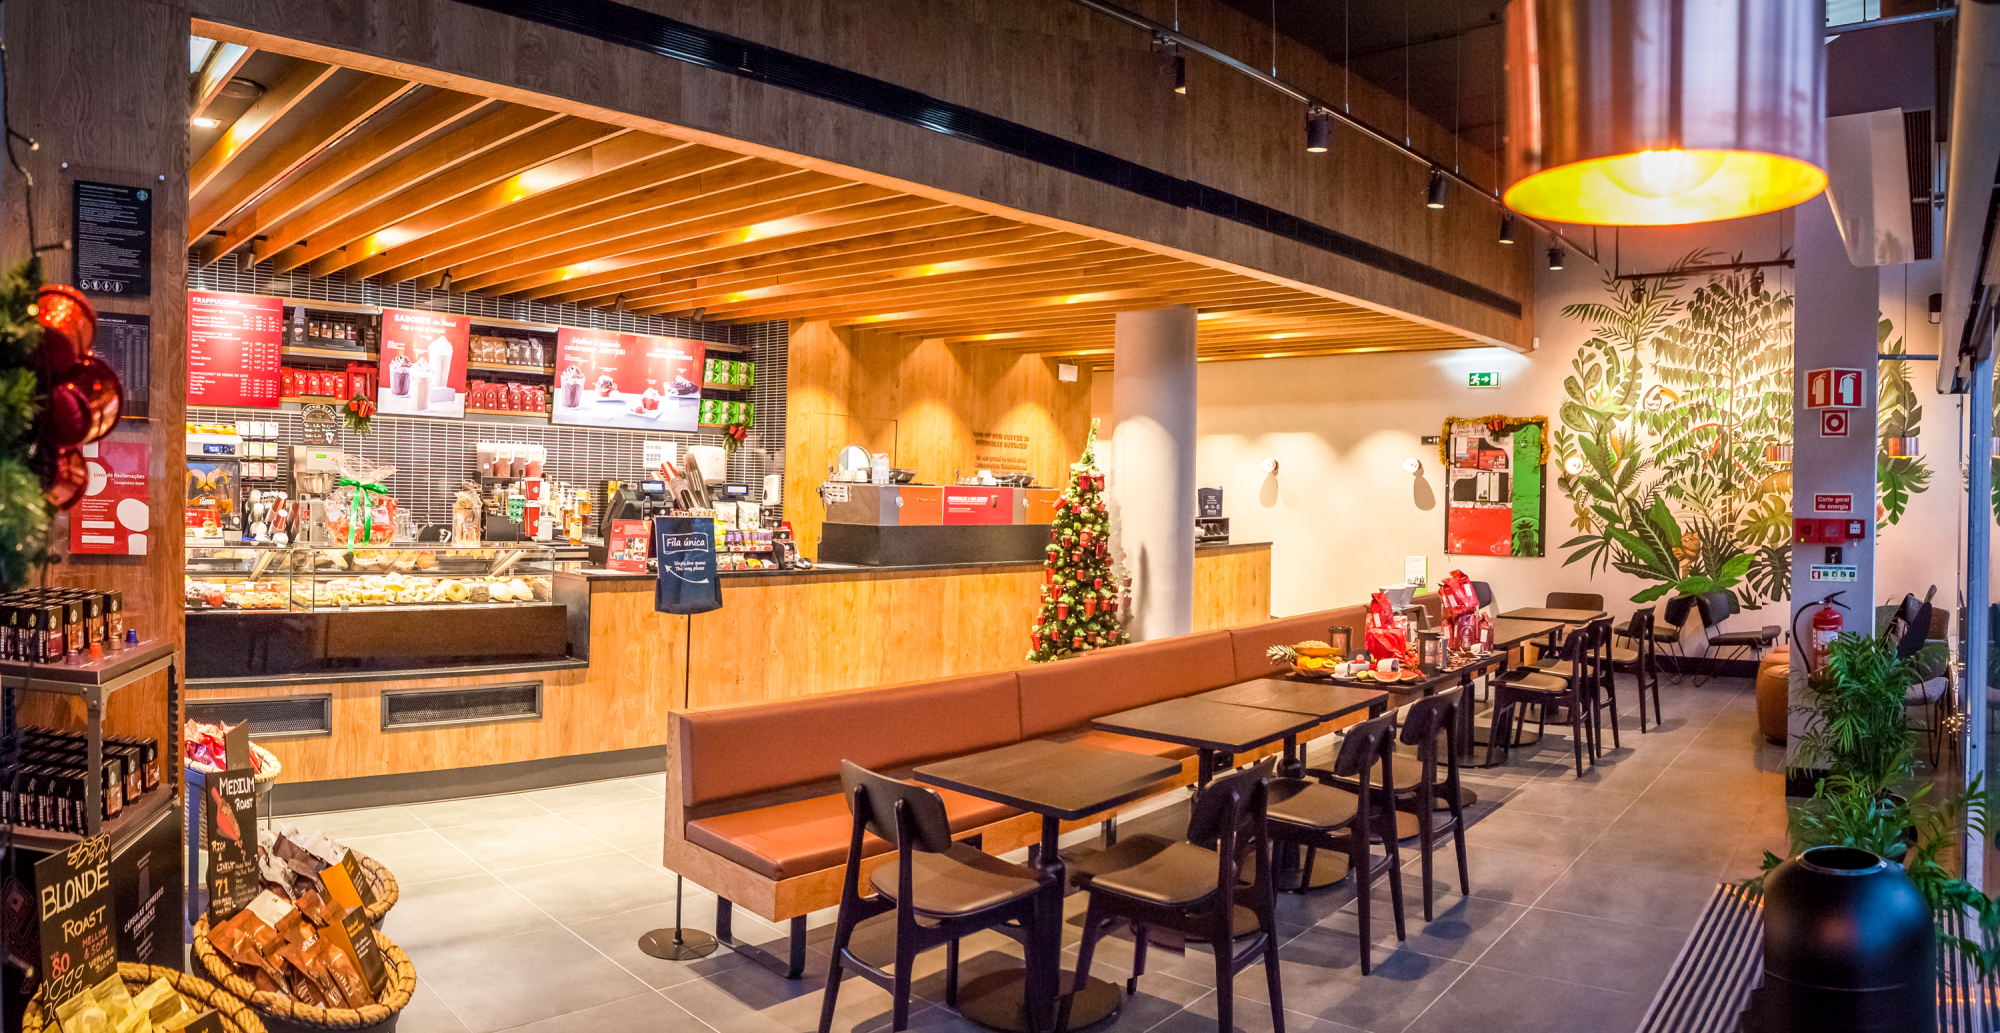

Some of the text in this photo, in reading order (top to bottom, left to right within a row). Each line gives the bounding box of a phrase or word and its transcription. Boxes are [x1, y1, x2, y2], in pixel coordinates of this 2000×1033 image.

[666, 537, 705, 547] Fila única
[219, 777, 255, 796] MEDIUM
[234, 798, 253, 812] ROAST
[42, 860, 109, 922] BLONDE
[215, 877, 229, 897] 71
[62, 905, 106, 943] ROAST
[82, 926, 108, 948] MELLOW
[91, 936, 108, 956] SOFT
[52, 953, 70, 979] 80
[88, 947, 114, 969] VERANDA
[95, 956, 114, 973] BLEND
